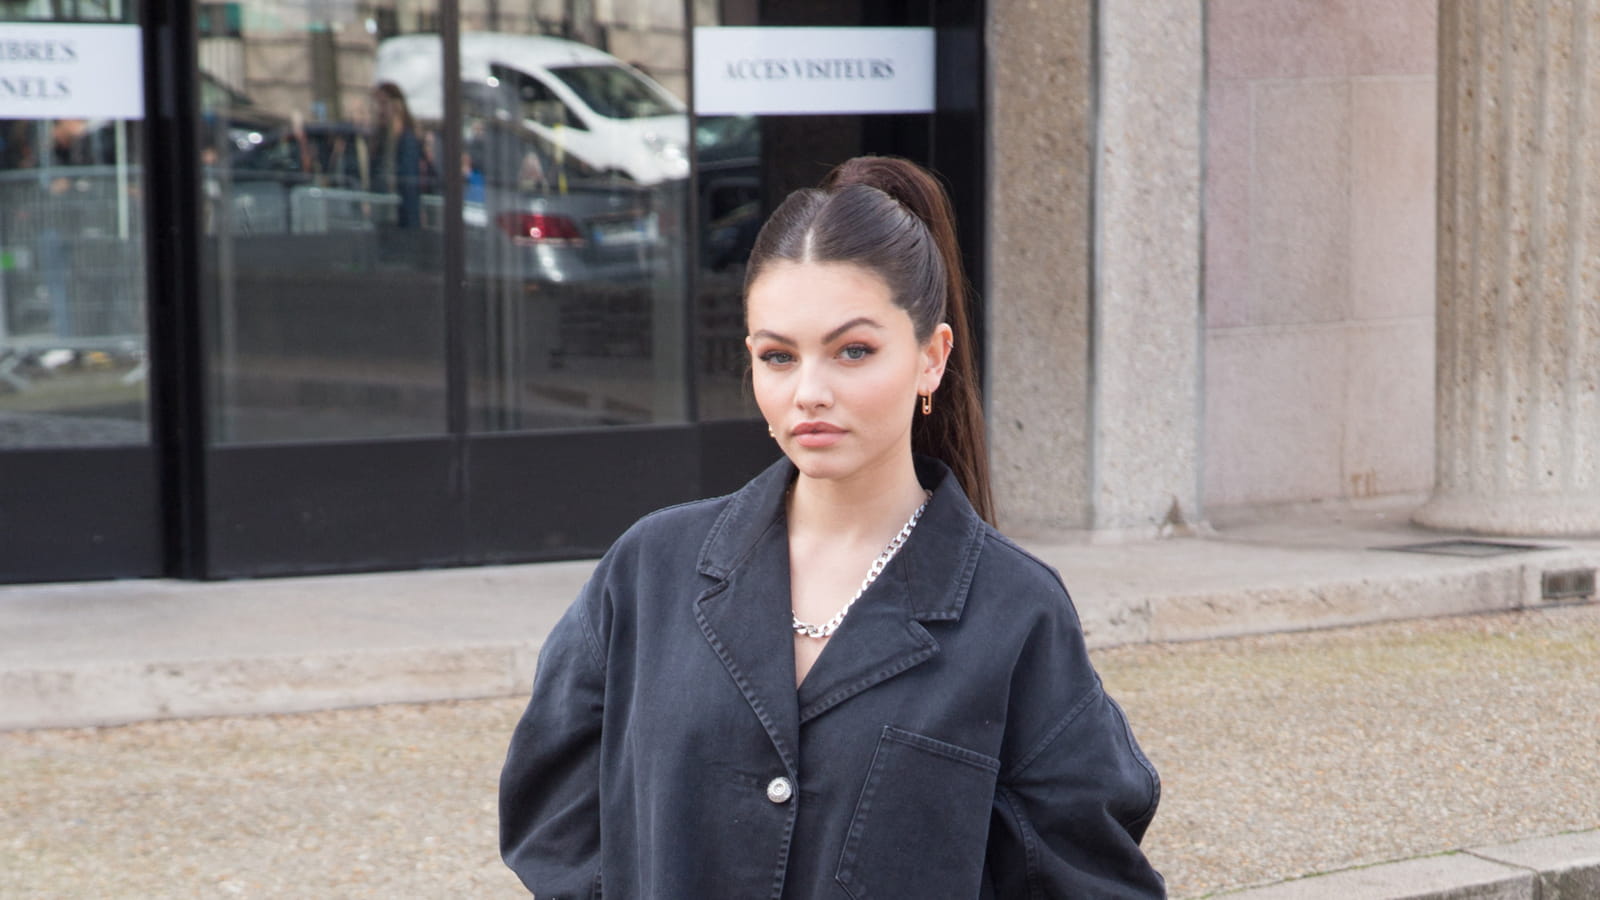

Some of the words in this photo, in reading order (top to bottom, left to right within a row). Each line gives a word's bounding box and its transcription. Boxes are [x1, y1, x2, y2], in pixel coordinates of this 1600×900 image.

[0, 41, 77, 62] BRES
[724, 58, 788, 79] ACCES
[790, 57, 895, 79] VISITEURS
